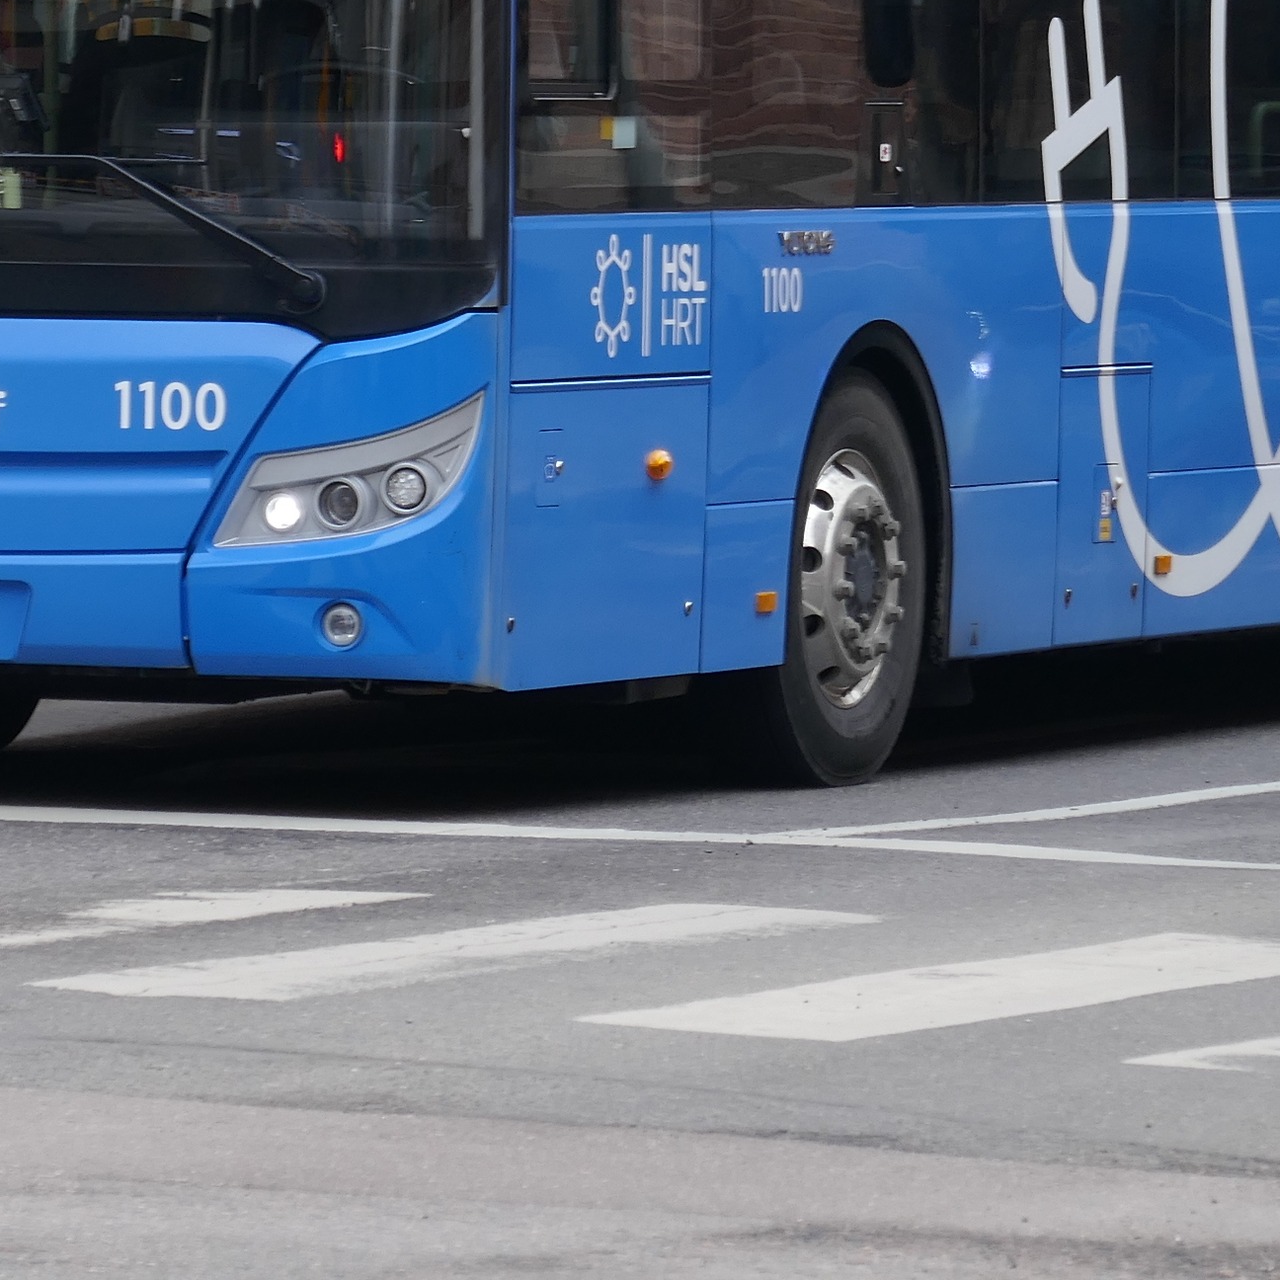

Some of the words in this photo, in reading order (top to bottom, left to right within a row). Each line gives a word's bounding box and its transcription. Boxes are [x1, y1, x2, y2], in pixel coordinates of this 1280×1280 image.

[661, 243, 708, 293] HSL
[762, 267, 804, 313] 1100
[660, 297, 707, 346] HRT
[113, 380, 228, 432] 1100
